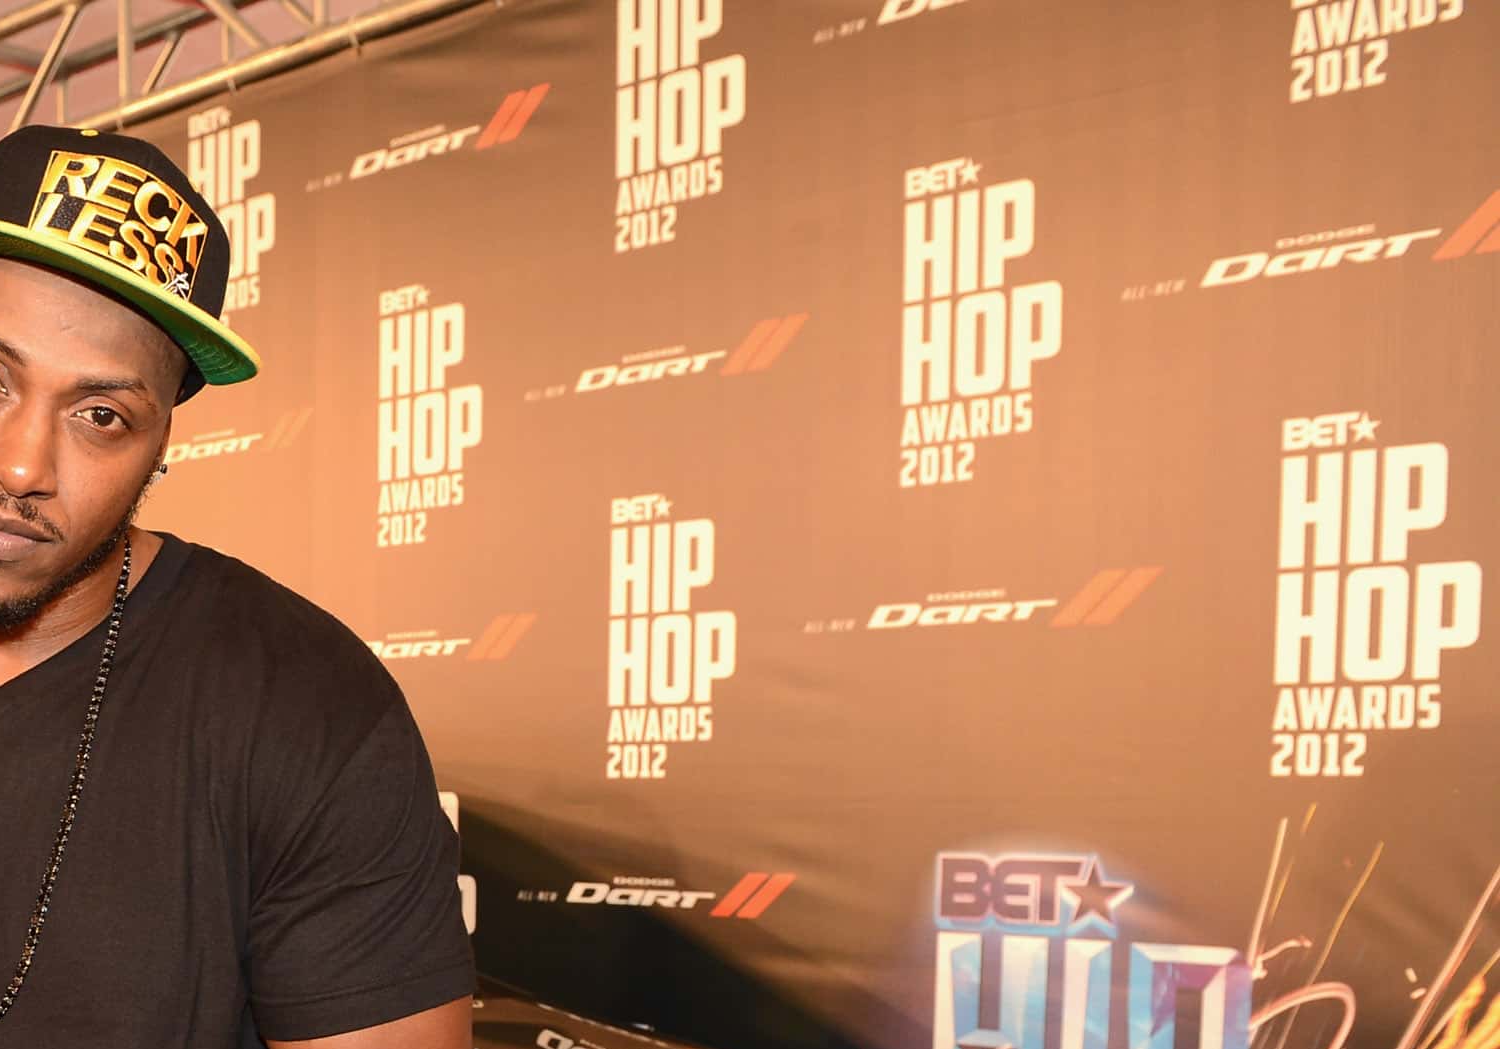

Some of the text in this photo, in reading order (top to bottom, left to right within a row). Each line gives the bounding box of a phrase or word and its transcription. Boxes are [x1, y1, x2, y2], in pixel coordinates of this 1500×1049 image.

[617, 0, 723, 87] HIP
[1290, 39, 1389, 104] 2012
[616, 54, 746, 178] HOP
[188, 120, 261, 205] HIP
[615, 156, 723, 216] AWARDS
[905, 158, 966, 199] BET
[32, 193, 185, 286] LESS
[46, 152, 208, 268] RECK
[218, 192, 277, 281] OP
[614, 205, 677, 253] 2012
[904, 179, 1036, 304] HIP
[379, 303, 465, 400] HIP
[902, 280, 1063, 407] HOP
[378, 385, 482, 482] HOP
[900, 392, 1033, 448] AWARDS
[1282, 412, 1361, 451] BET
[377, 473, 464, 514] AWARDS
[900, 442, 976, 488] 2012
[377, 511, 427, 548] 2012
[611, 495, 658, 524] BET
[1278, 442, 1449, 569] HIP
[609, 518, 715, 617] HIP
[607, 610, 737, 707] HOP
[1273, 561, 1483, 685] HOP
[606, 705, 713, 743] AWARDS
[1272, 684, 1442, 731] AWARDS
[606, 743, 668, 779] 2012
[1270, 733, 1368, 777] 2012
[936, 852, 1086, 927] BET
